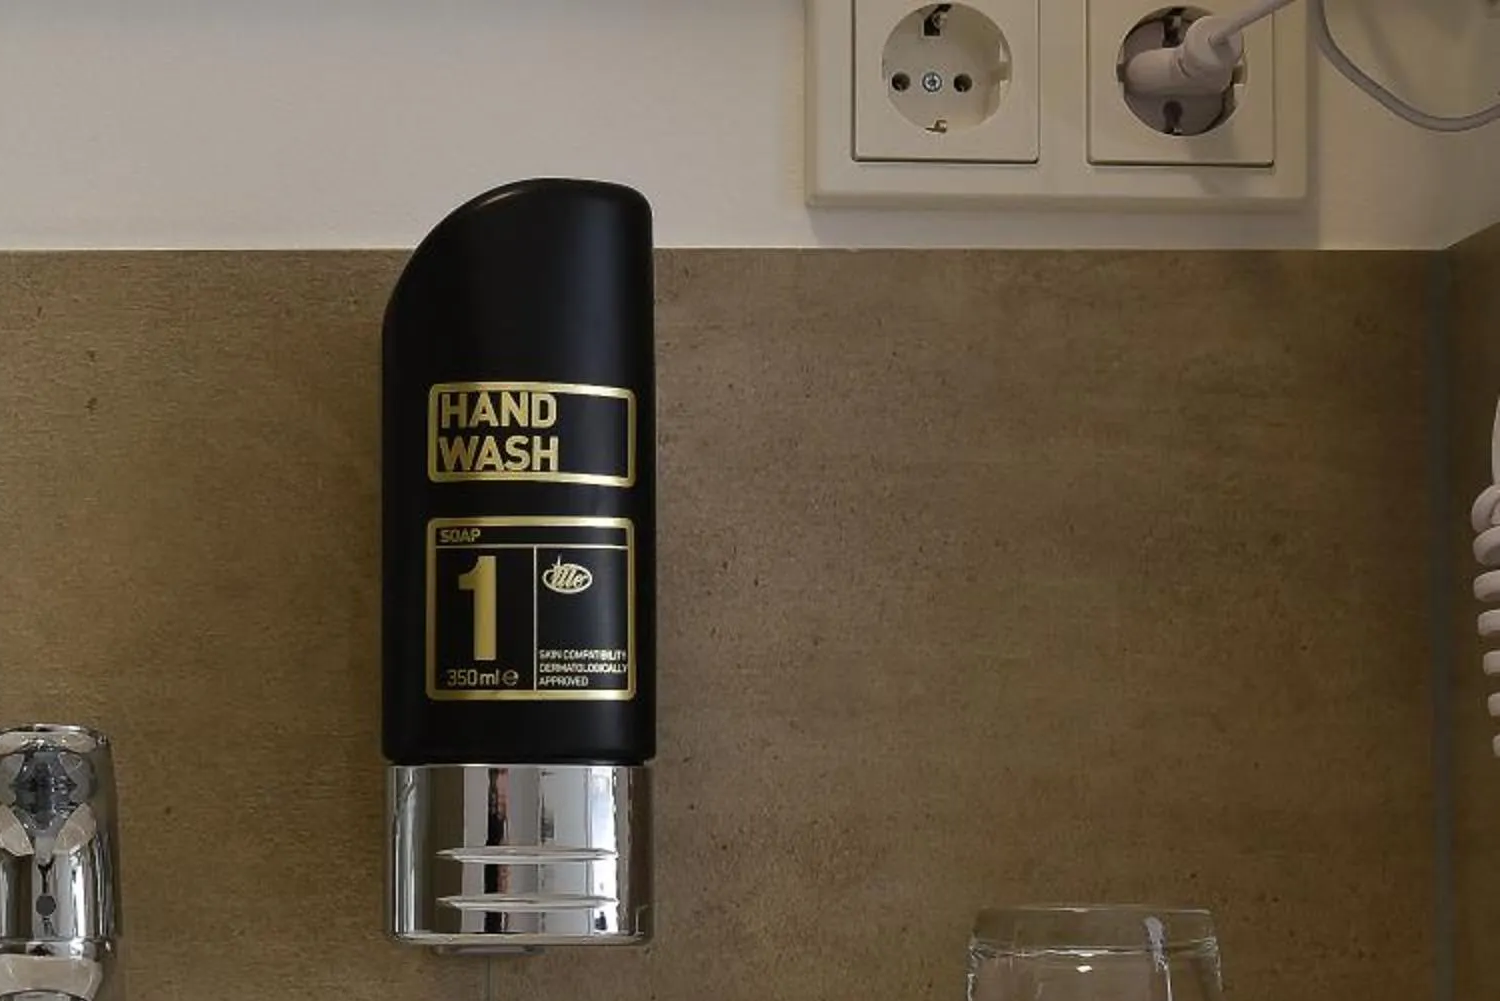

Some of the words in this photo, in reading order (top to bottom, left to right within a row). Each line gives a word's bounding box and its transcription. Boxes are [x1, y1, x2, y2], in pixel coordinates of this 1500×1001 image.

[439, 391, 557, 429] HAND
[438, 437, 559, 471] WASH
[440, 528, 481, 543] SOAP
[458, 555, 496, 661] 1
[539, 676, 589, 687] APPROVED
